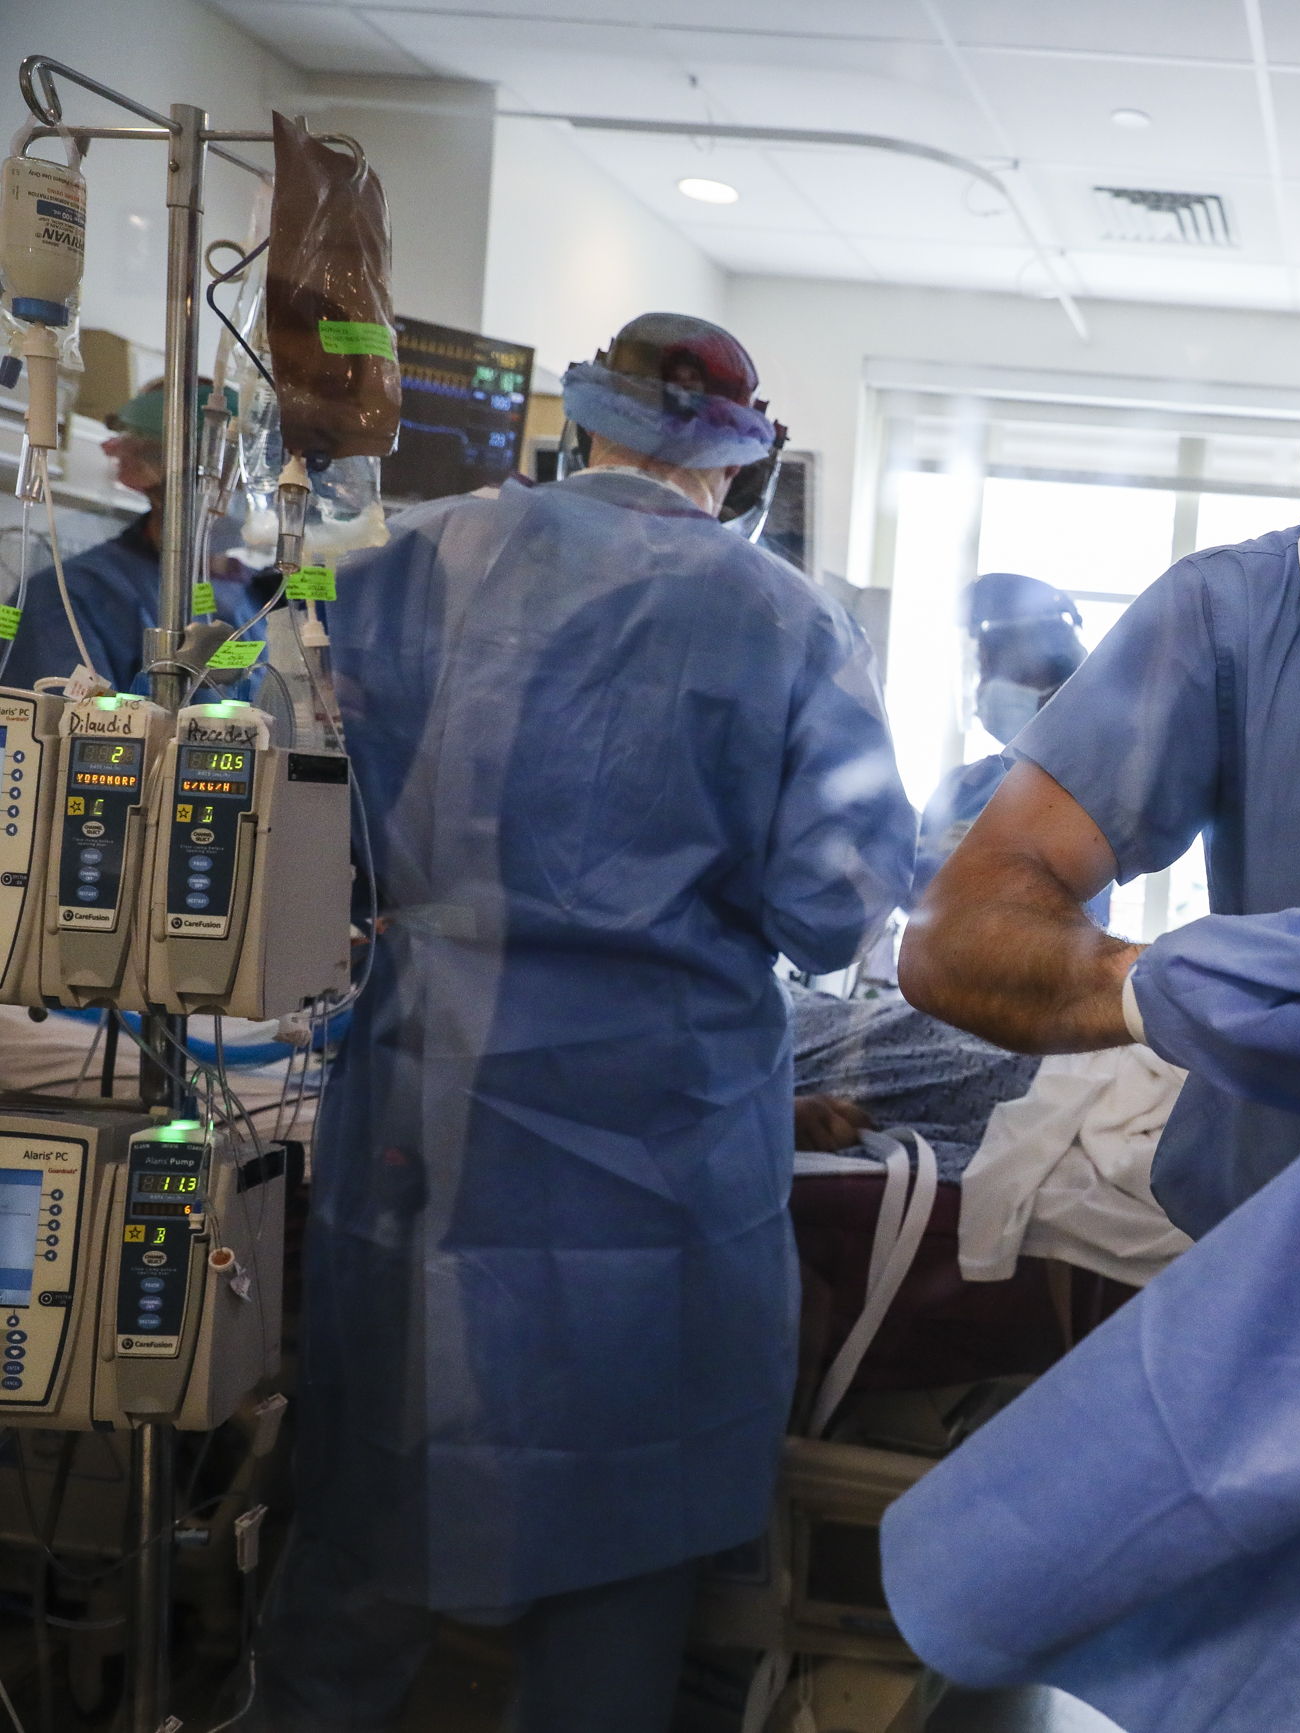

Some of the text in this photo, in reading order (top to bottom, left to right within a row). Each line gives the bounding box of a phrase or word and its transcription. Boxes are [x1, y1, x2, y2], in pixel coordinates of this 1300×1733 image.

[62, 212, 73, 221] 100
[19, 708, 30, 717] PC
[68, 711, 133, 736] Dilaudid
[187, 717, 260, 747] Precedex
[111, 746, 124, 763] 2
[210, 753, 244, 770] 10.5
[94, 799, 104, 815] C
[74, 912, 110, 921] CareFusion
[183, 920, 221, 929] CareFusion
[55, 1152, 69, 1162] PC
[169, 1158, 195, 1167] Pump
[164, 1176, 197, 1192] 11.3
[184, 1205, 191, 1214] 6
[153, 1227, 166, 1244] B
[135, 1341, 173, 1349] CareFusion
